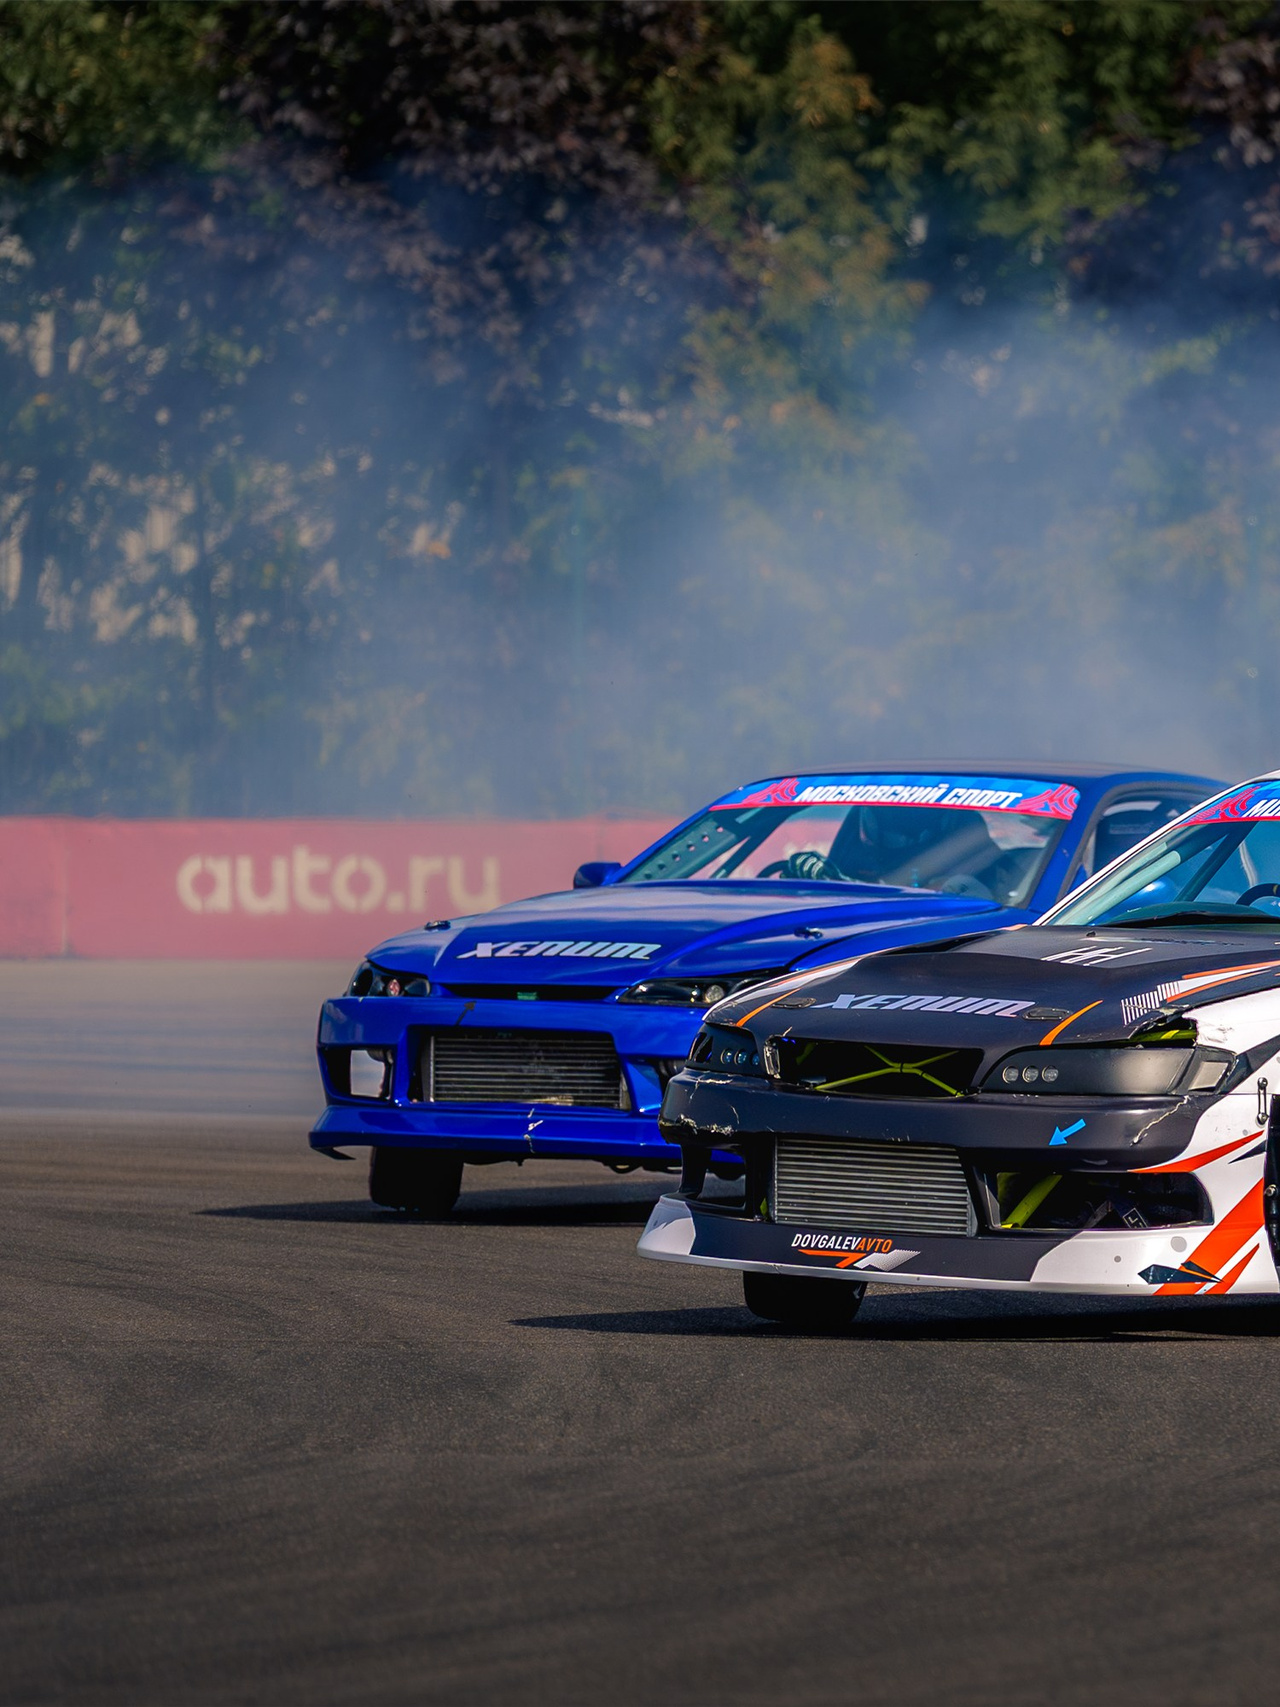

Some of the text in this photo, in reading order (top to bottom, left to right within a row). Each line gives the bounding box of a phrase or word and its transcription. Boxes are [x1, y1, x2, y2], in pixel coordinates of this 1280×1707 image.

[794, 784, 1023, 809] МОСКОВСКИЙ СПОРТ
[176, 845, 499, 915] auto.ru
[456, 941, 662, 959] XENUM
[809, 994, 1036, 1018] XENUM
[791, 1233, 893, 1253] DOVGALEVAVTO
